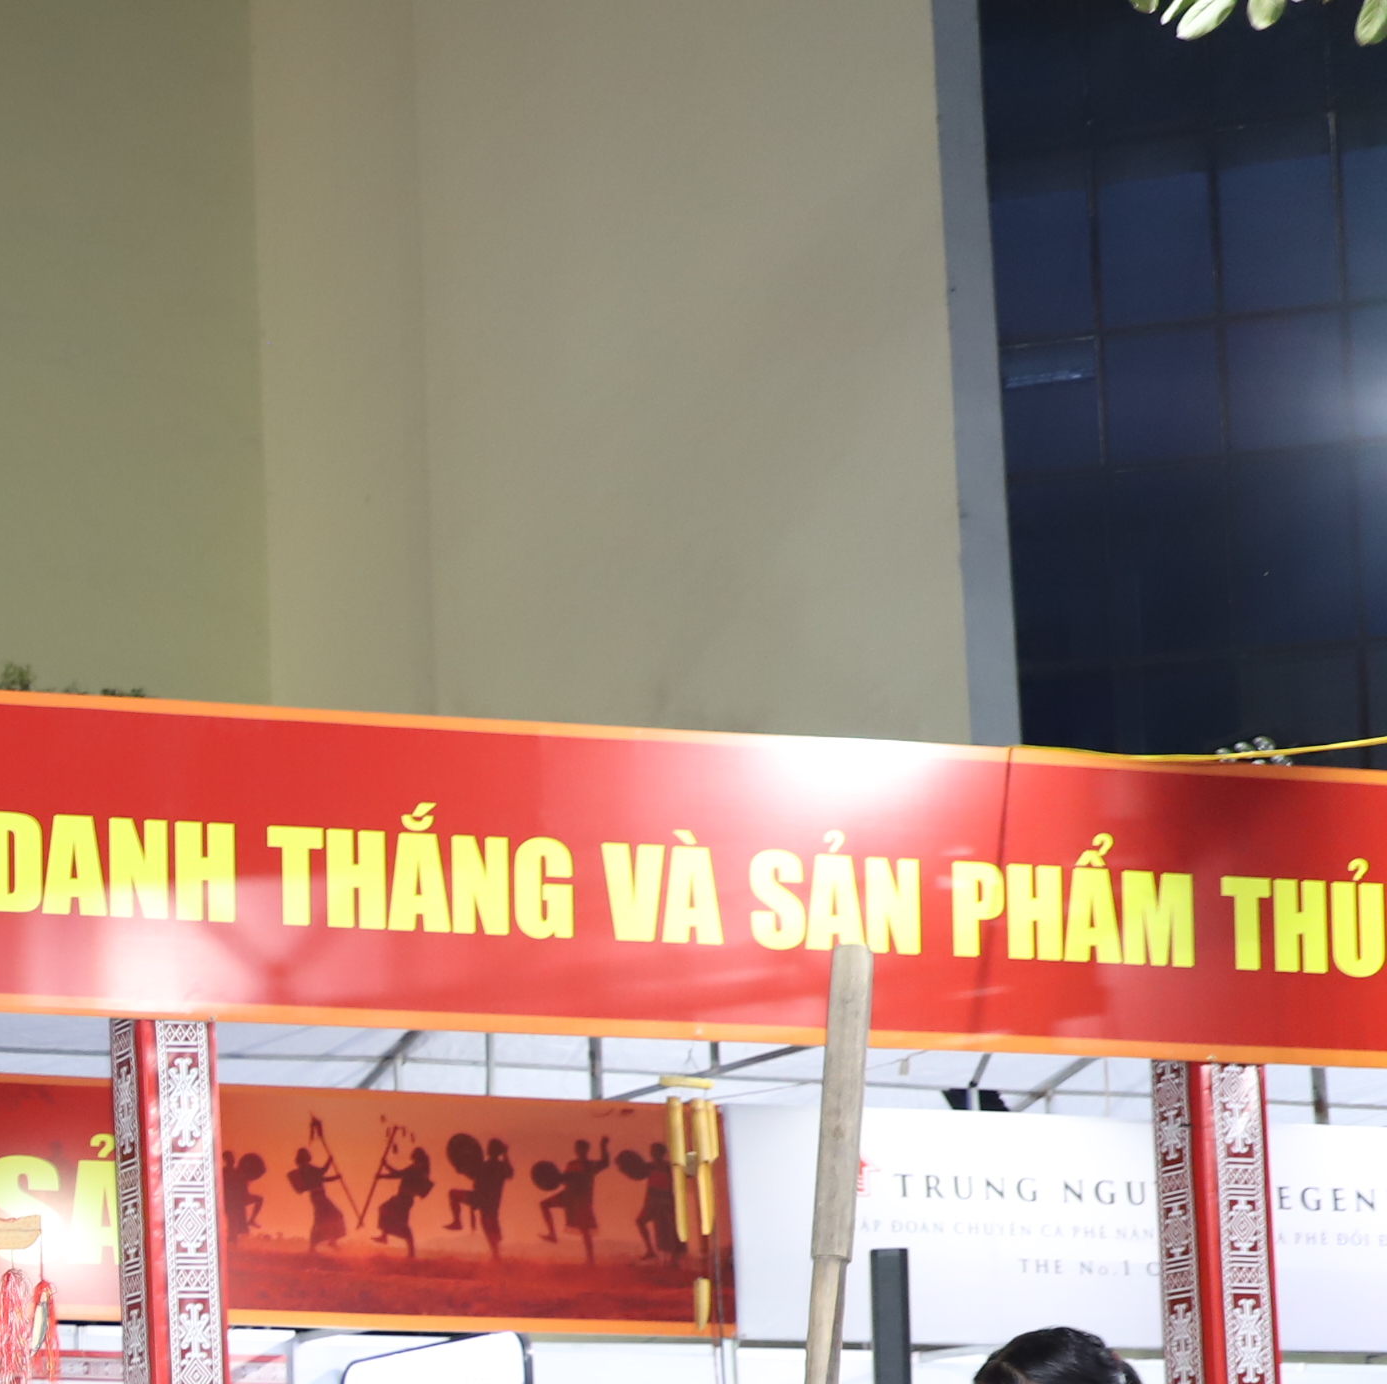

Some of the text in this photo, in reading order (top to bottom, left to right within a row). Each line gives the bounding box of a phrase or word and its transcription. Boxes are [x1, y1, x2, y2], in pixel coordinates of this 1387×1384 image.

[266, 801, 575, 940] THẮNG
[600, 829, 725, 947] VÀ
[748, 829, 922, 956] SẢN
[950, 832, 1195, 969] PHẨM
[1220, 857, 1385, 979] THỦ
[893, 1173, 1387, 1212] TRUNG NGU EGEN
[1017, 1257, 1065, 1275] THE
[1079, 1258, 1132, 1278] No.1
